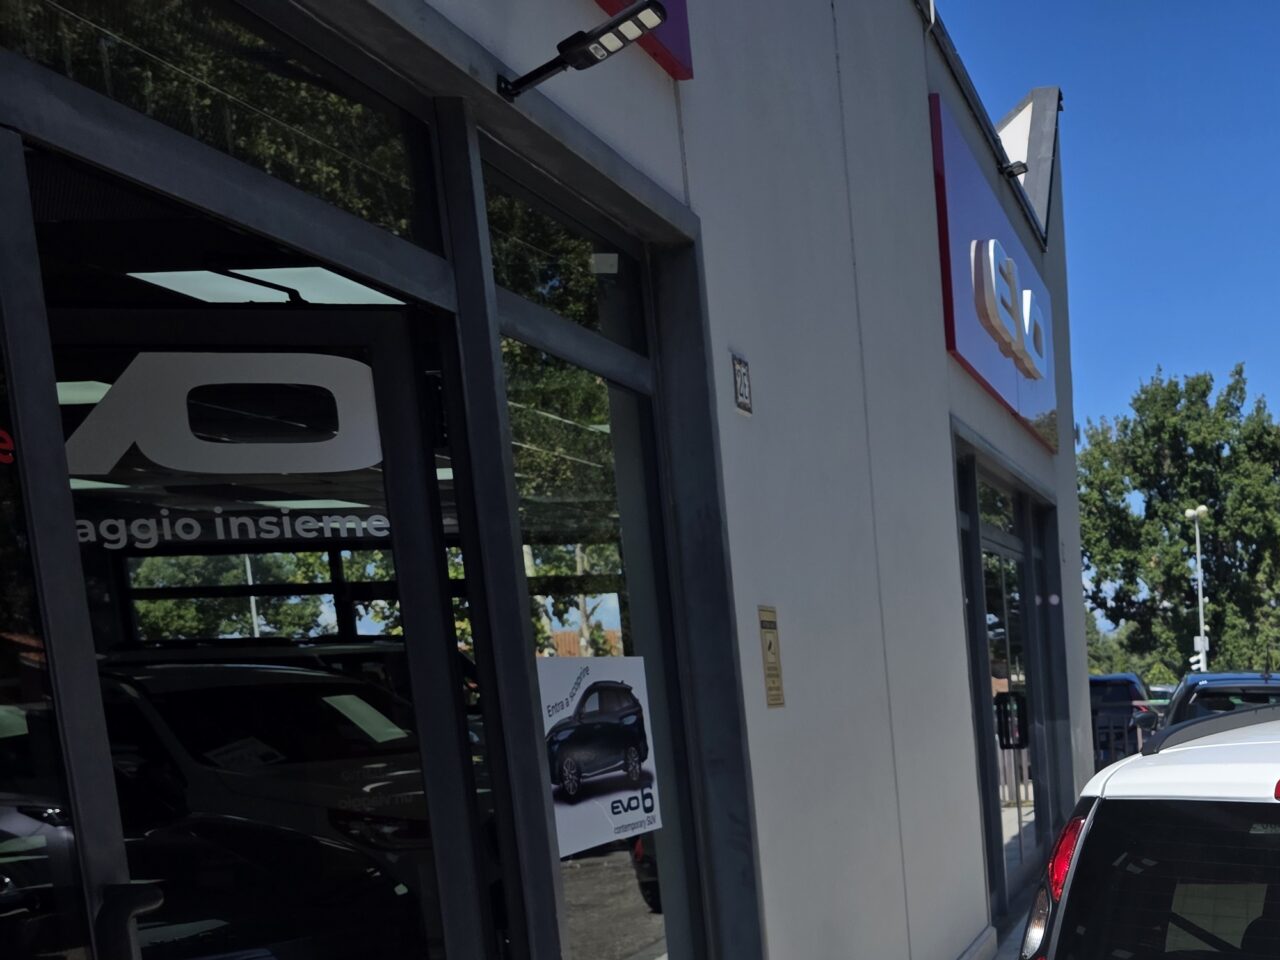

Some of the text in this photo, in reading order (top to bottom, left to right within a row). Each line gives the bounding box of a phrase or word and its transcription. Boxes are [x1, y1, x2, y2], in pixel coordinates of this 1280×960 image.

[76, 506, 391, 550] aggio insieme
[546, 700, 565, 718] Entra
